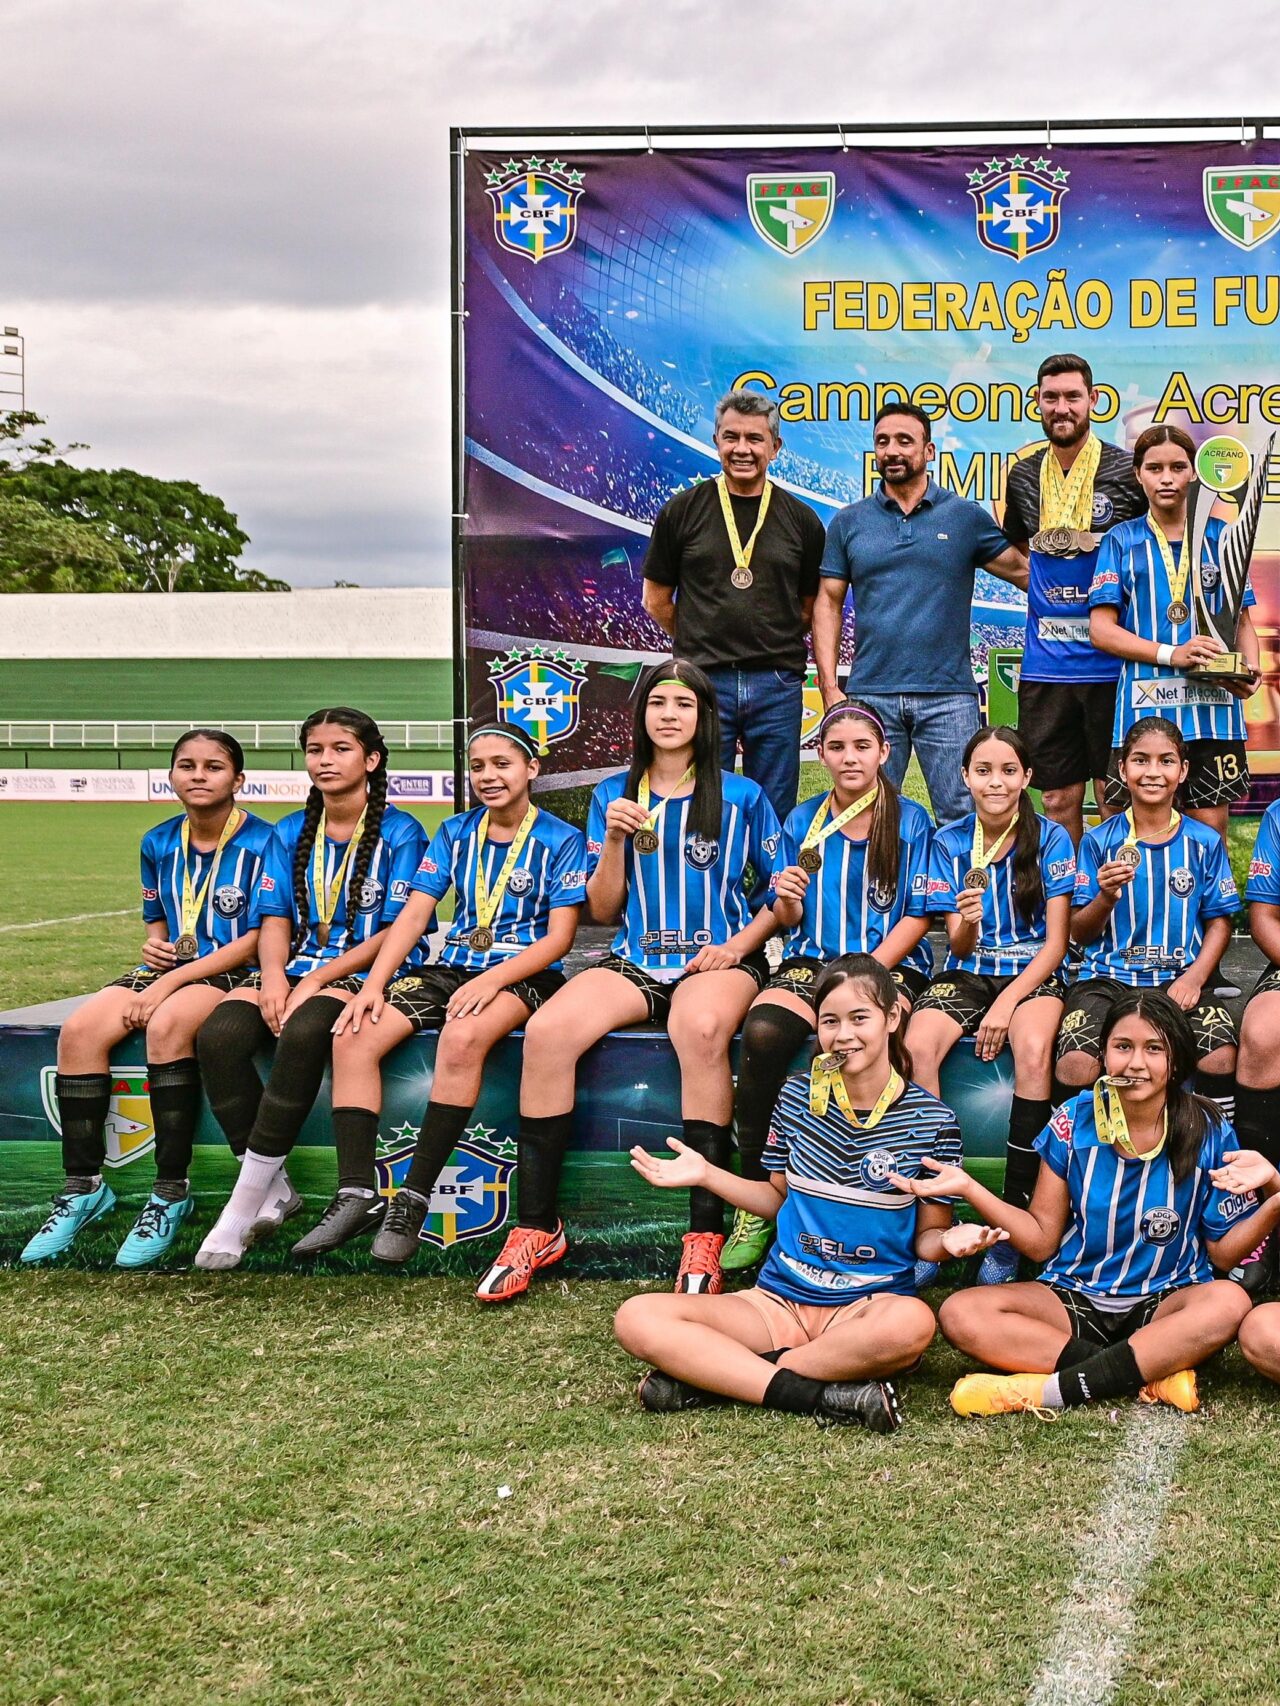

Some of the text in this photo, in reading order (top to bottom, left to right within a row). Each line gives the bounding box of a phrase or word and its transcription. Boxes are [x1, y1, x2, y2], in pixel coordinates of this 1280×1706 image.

[1216, 176, 1279, 189] FFAC
[760, 183, 822, 196] FFAC
[520, 209, 555, 219] CBF
[1002, 208, 1040, 218] CBF
[803, 268, 1113, 343] FEDERAÇÃO
[1129, 277, 1198, 329] DE
[1204, 449, 1244, 459] ACREANO
[522, 697, 558, 706] CBF
[1214, 753, 1239, 781] 13
[241, 783, 310, 796] UNINORT
[1199, 1006, 1234, 1027] 20
[873, 1153, 890, 1162] ADGX
[1152, 1211, 1174, 1221] ADGX
